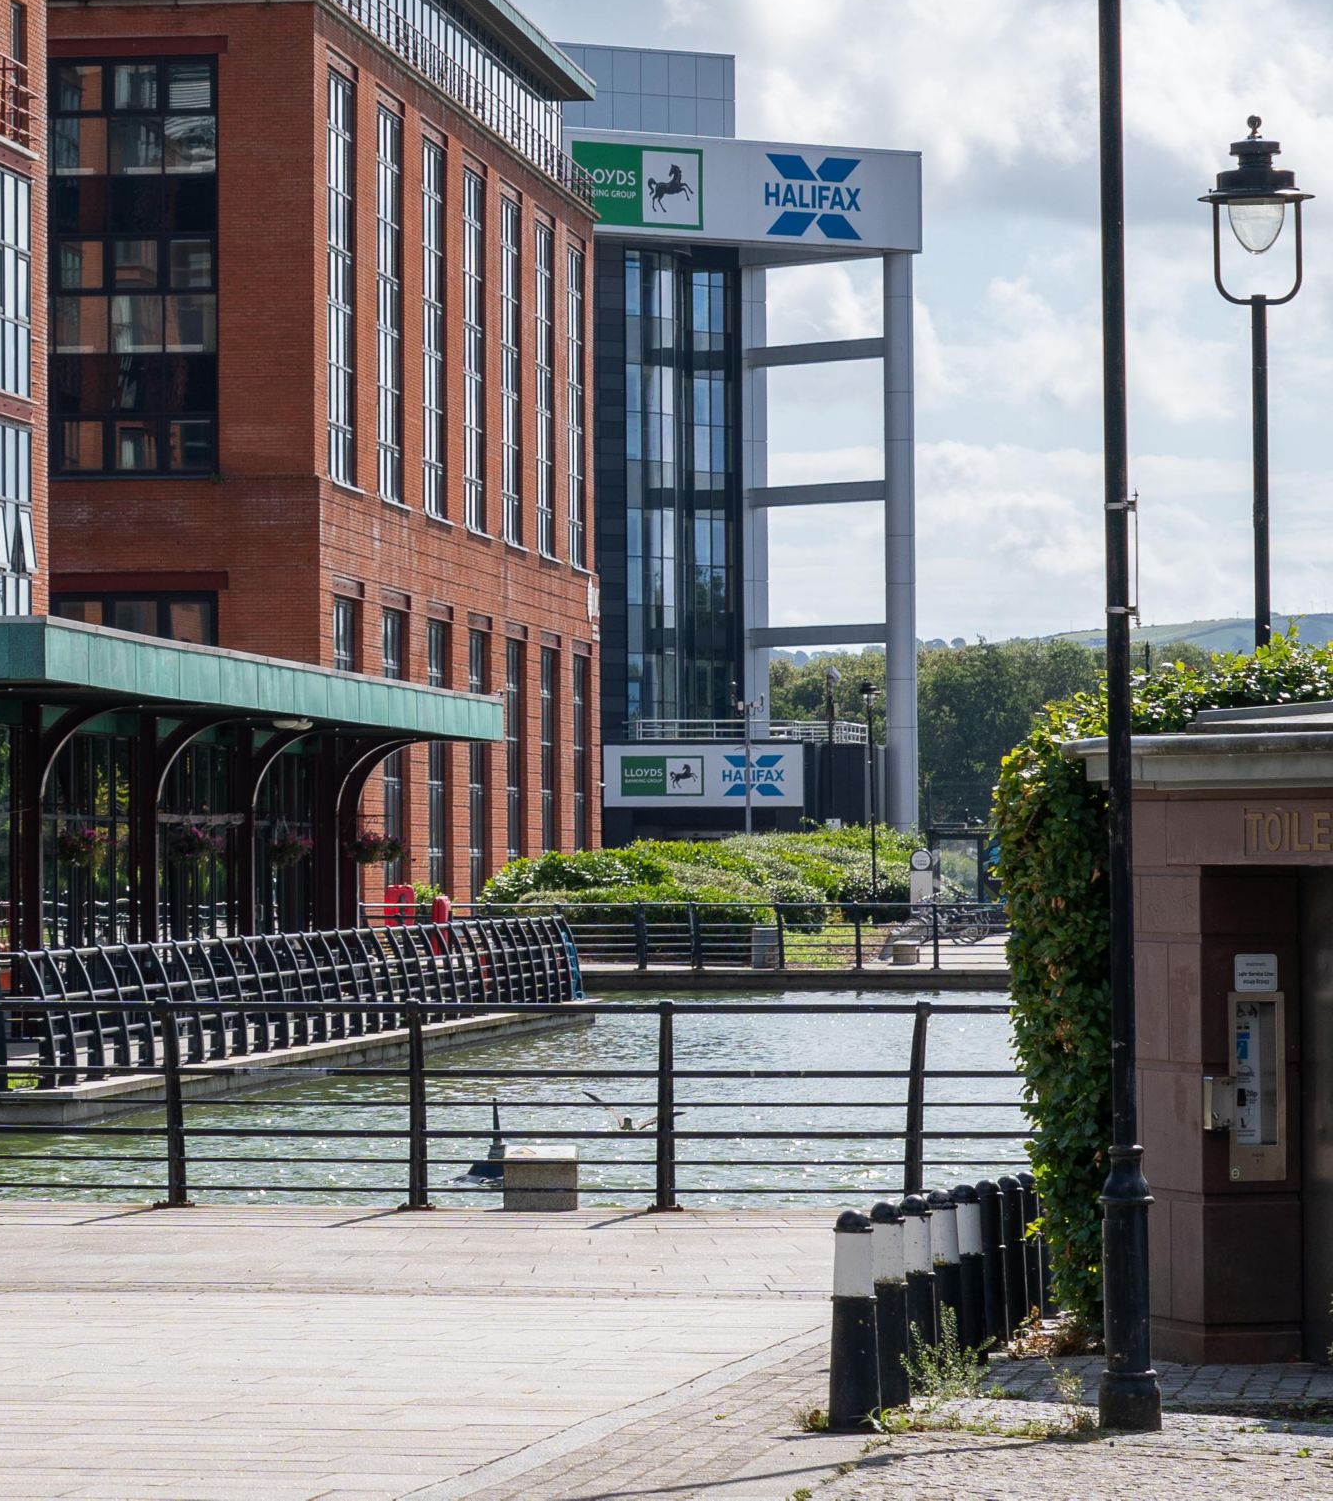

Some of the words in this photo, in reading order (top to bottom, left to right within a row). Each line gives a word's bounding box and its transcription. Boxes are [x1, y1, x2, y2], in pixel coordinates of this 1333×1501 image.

[611, 190, 637, 199] GROUP
[764, 182, 861, 212] HALIFAX
[624, 768, 663, 777] LLOYDS
[1247, 811, 1333, 852] TOILE
